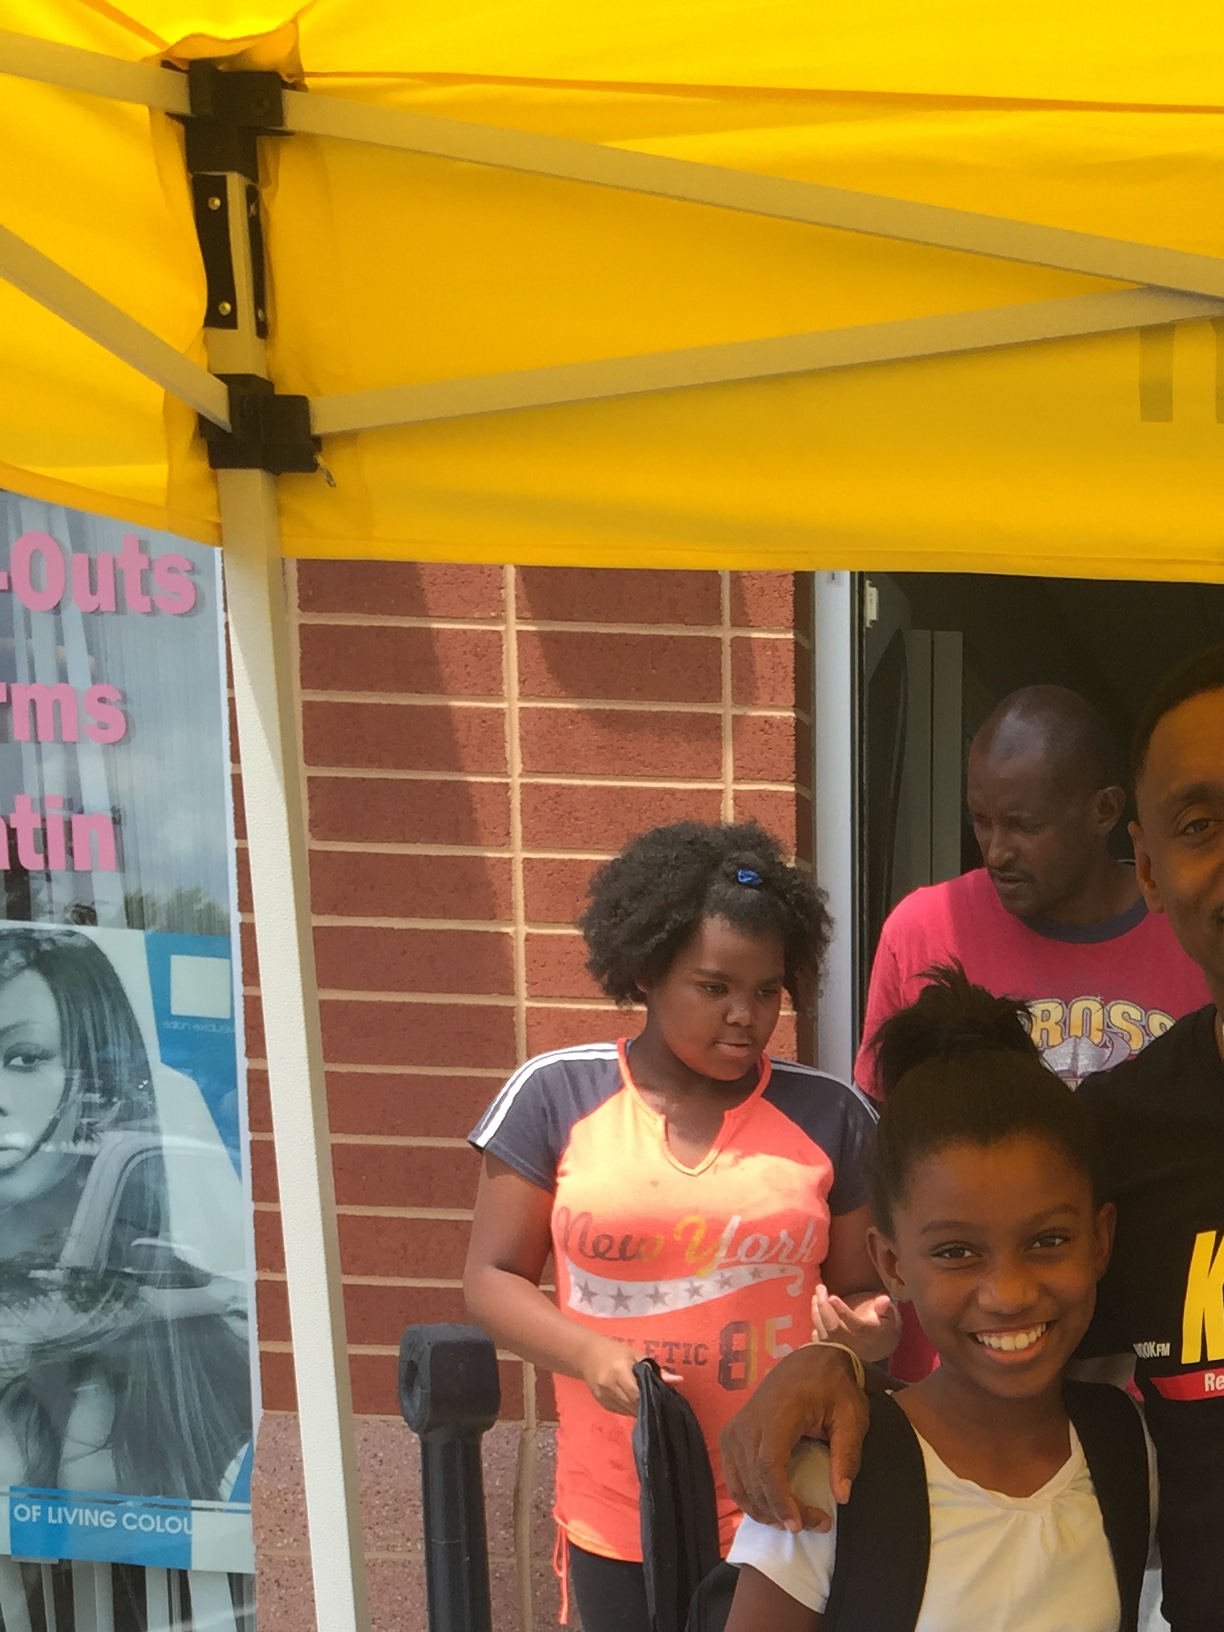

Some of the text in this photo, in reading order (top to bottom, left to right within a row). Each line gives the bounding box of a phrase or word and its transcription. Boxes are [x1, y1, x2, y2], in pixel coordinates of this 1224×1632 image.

[0, 795, 117, 871] tin
[553, 1206, 818, 1279] New York
[13, 1503, 42, 1522] OF
[47, 1506, 116, 1528] LIVING
